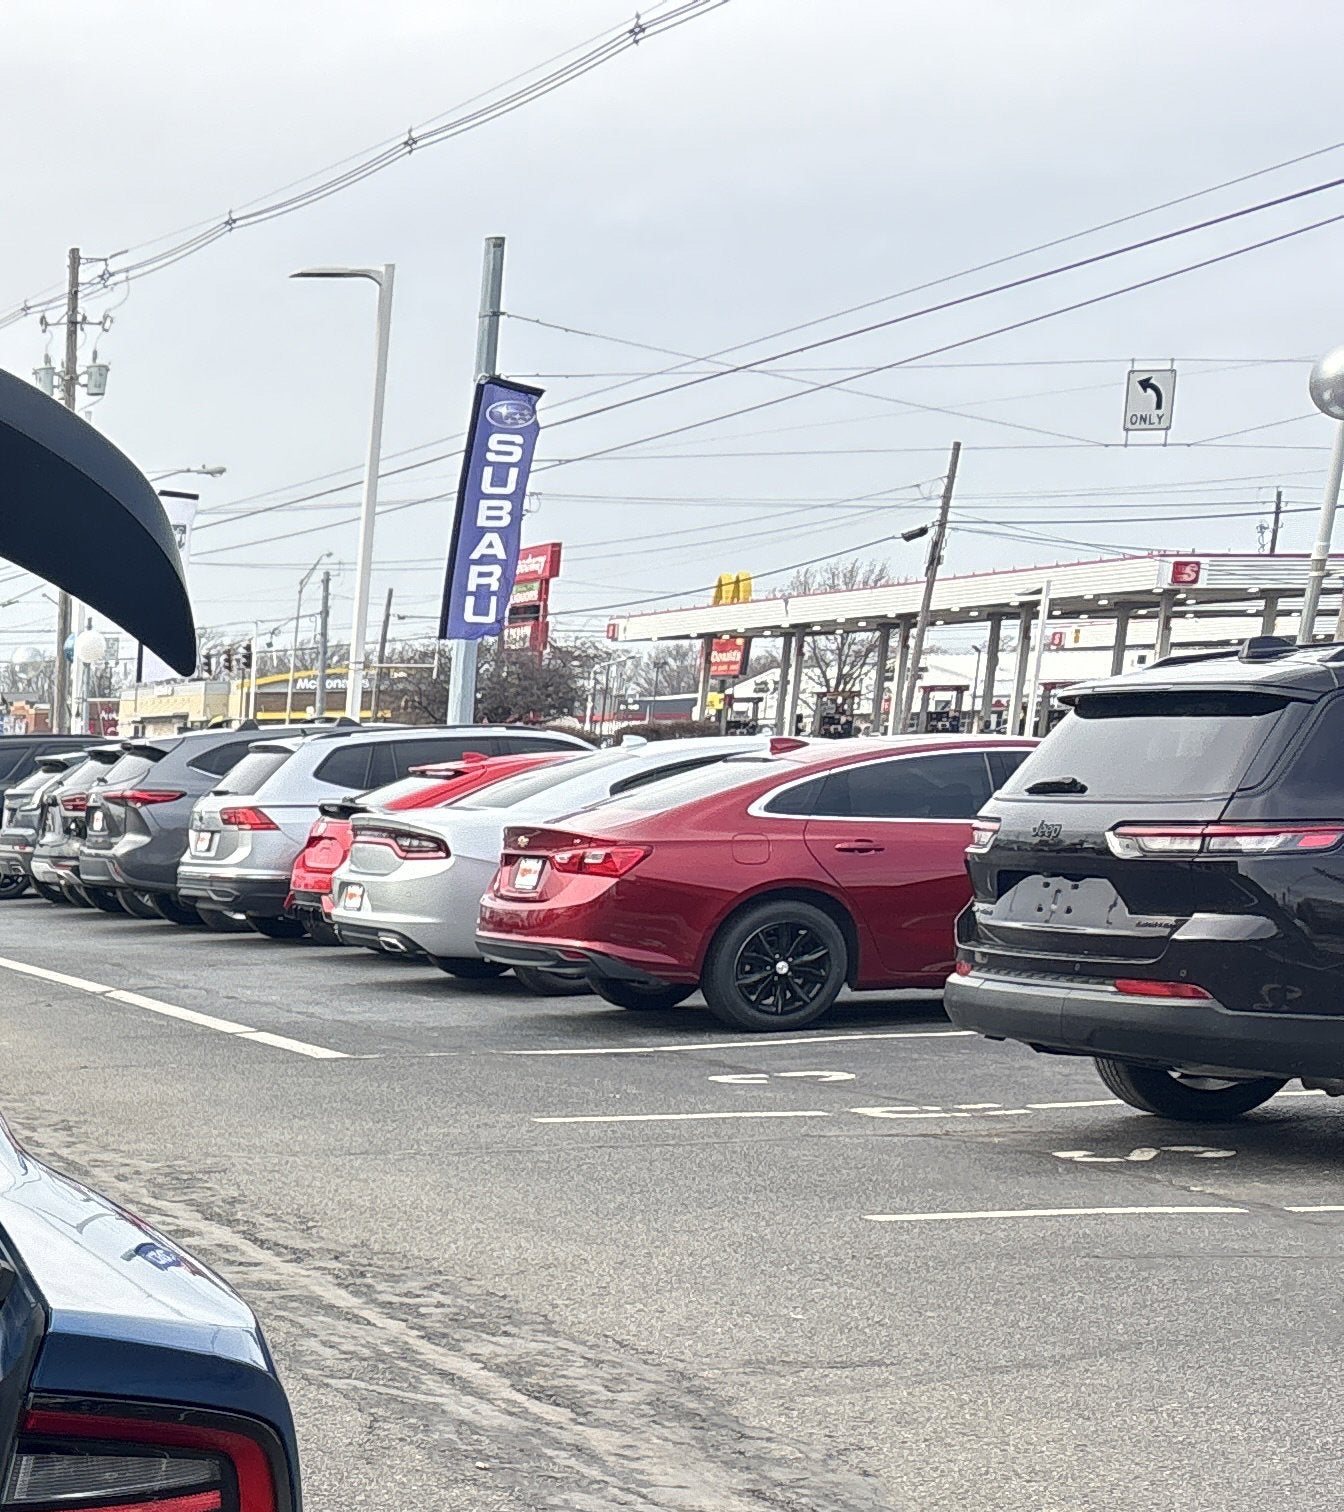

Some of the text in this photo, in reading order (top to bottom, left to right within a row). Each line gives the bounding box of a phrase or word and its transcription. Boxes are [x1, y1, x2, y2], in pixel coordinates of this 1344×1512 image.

[1129, 413, 1165, 426] ONLY
[463, 432, 524, 624] SUBARU
[1032, 819, 1062, 841] Jeep
